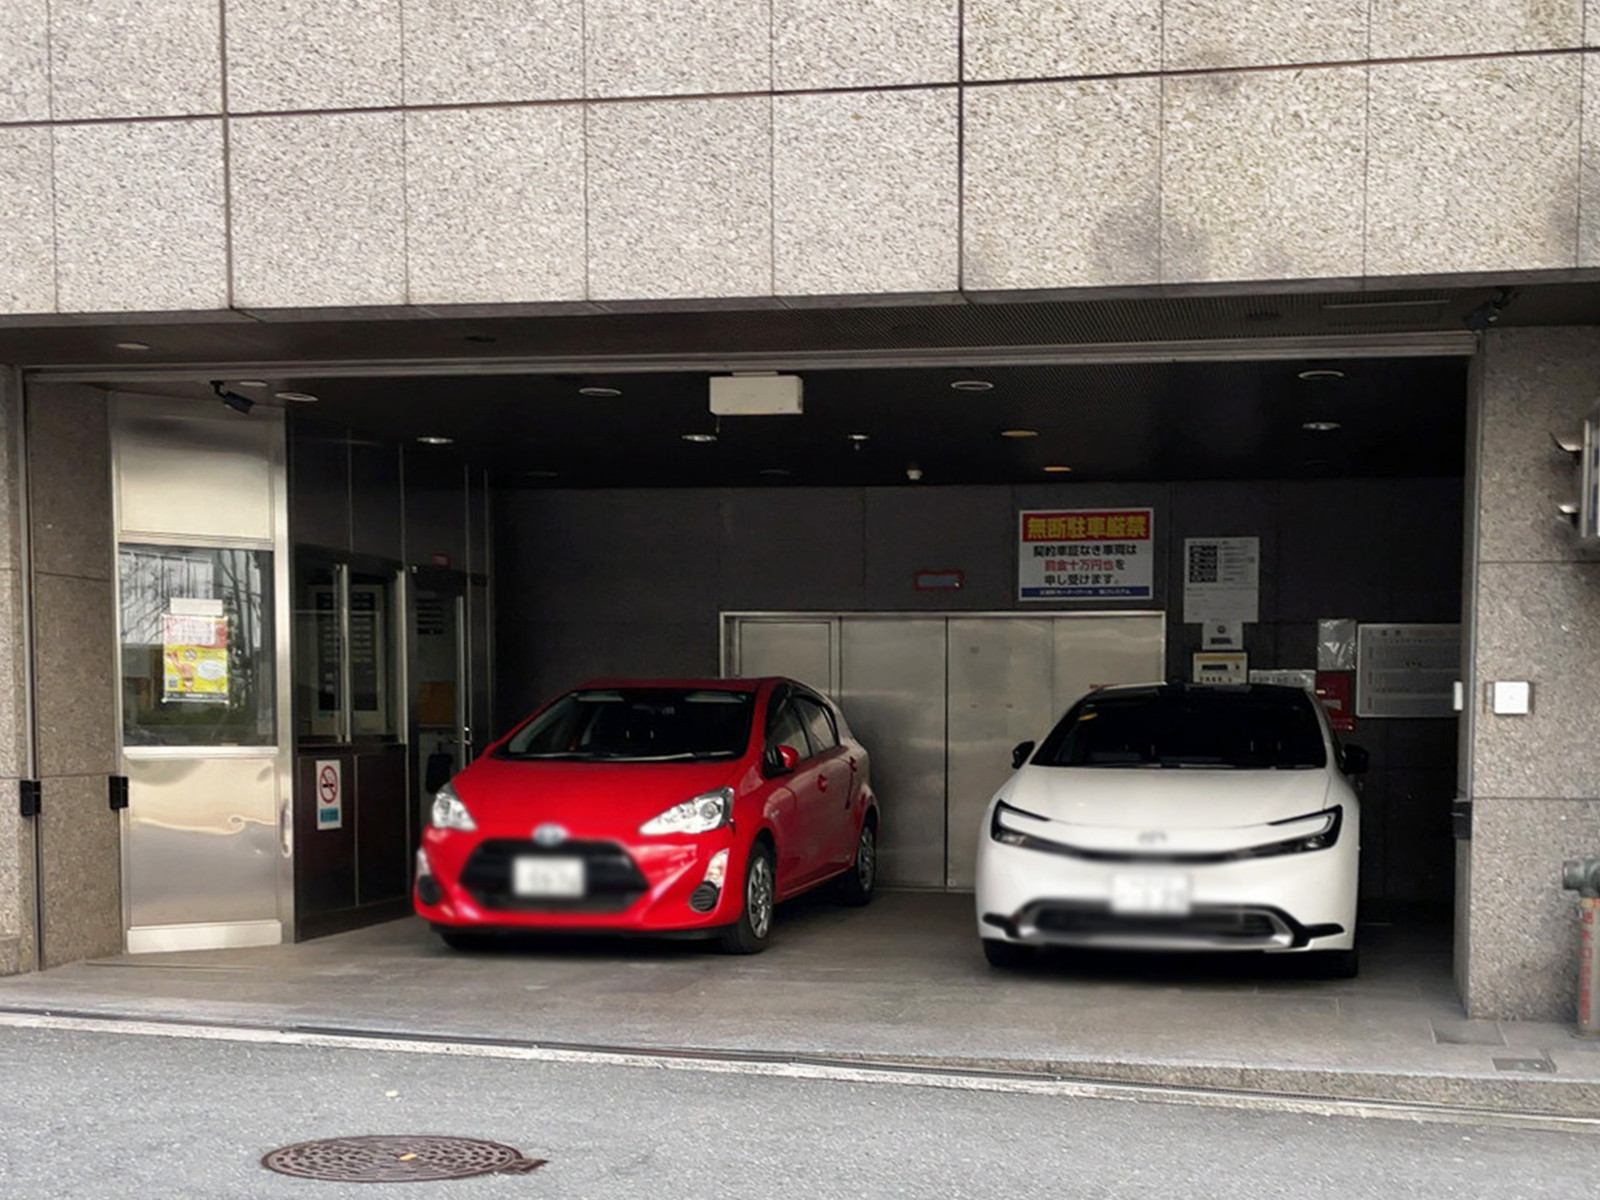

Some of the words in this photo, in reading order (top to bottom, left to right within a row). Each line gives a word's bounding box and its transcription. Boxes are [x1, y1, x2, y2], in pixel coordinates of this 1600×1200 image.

[1028, 516, 1145, 539] 無断駐車厳禁
[1045, 574, 1119, 586] 申し受けます。
